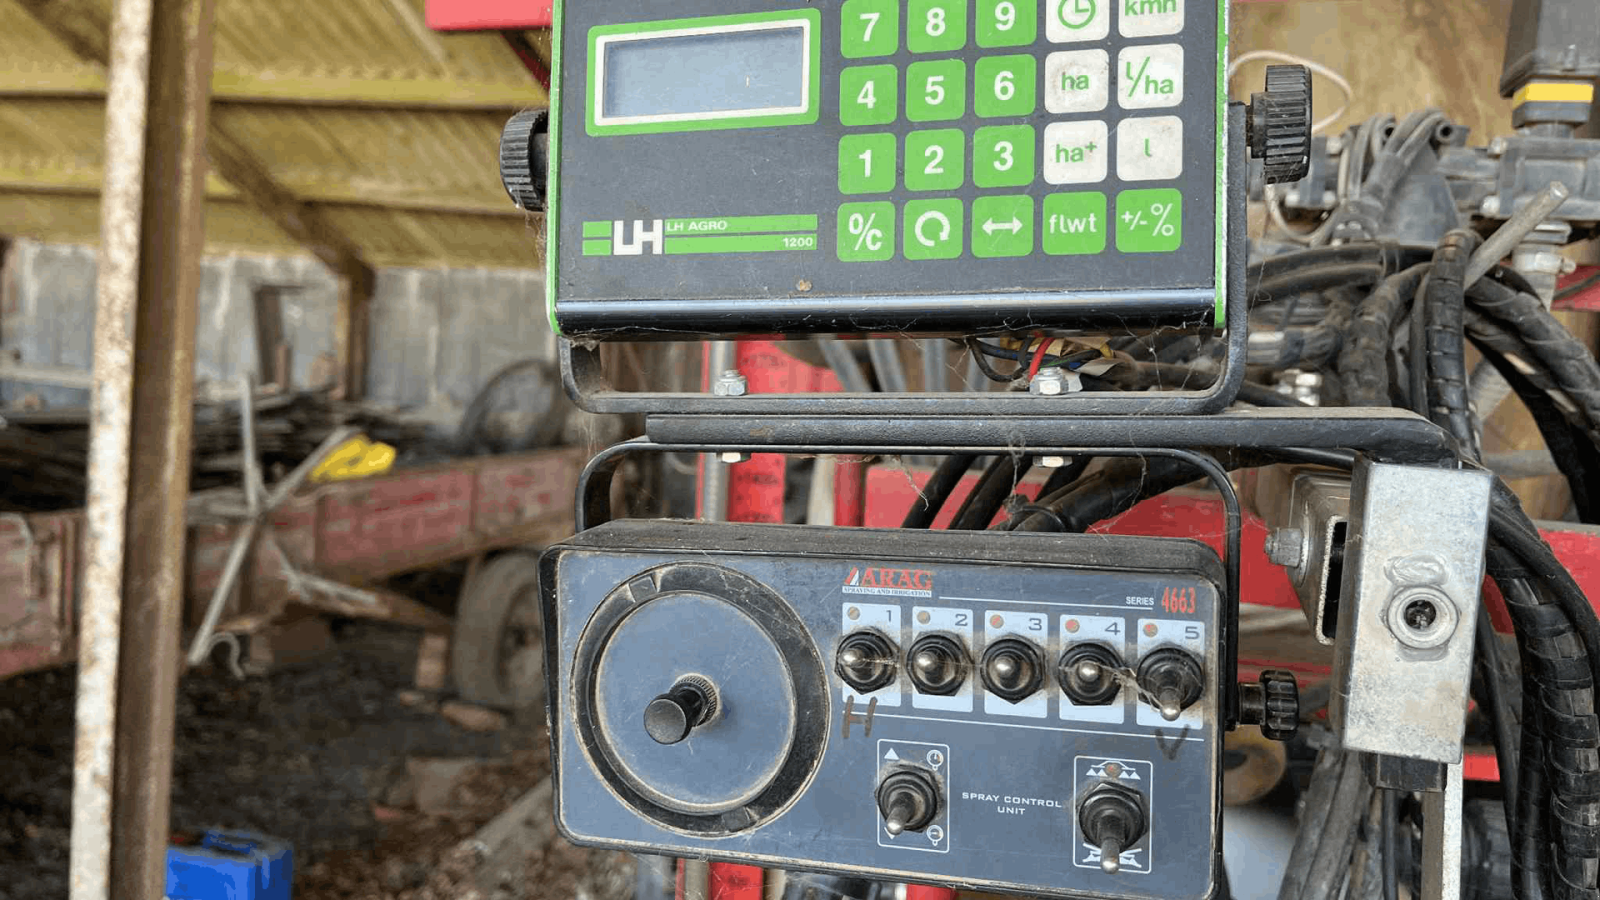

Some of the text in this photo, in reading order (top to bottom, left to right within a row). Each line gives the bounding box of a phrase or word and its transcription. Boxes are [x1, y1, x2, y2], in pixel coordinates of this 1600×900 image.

[859, 13, 880, 42] 7
[925, 7, 946, 37] 8
[995, 1, 1016, 31] 9
[857, 81, 877, 109] 4
[924, 75, 945, 105] 5
[994, 70, 1015, 101] 6
[1061, 73, 1089, 91] ha
[858, 149, 873, 178] 1
[924, 144, 944, 175] 2
[993, 141, 1014, 171] 3
[666, 221, 727, 231] LH AGRO
[1049, 212, 1098, 234] flwt
[613, 220, 662, 255] LH
[782, 236, 813, 248] 1200
[1125, 586, 1196, 614] SERIES 4663
[885, 610, 892, 622] 1
[954, 613, 968, 627] 2
[1028, 617, 1042, 631] 3
[1104, 621, 1122, 636] 4
[1184, 626, 1200, 640] 5
[841, 694, 878, 739] H
[962, 792, 1061, 807] SPRAY CONTROL
[997, 806, 1025, 815] UNIT
